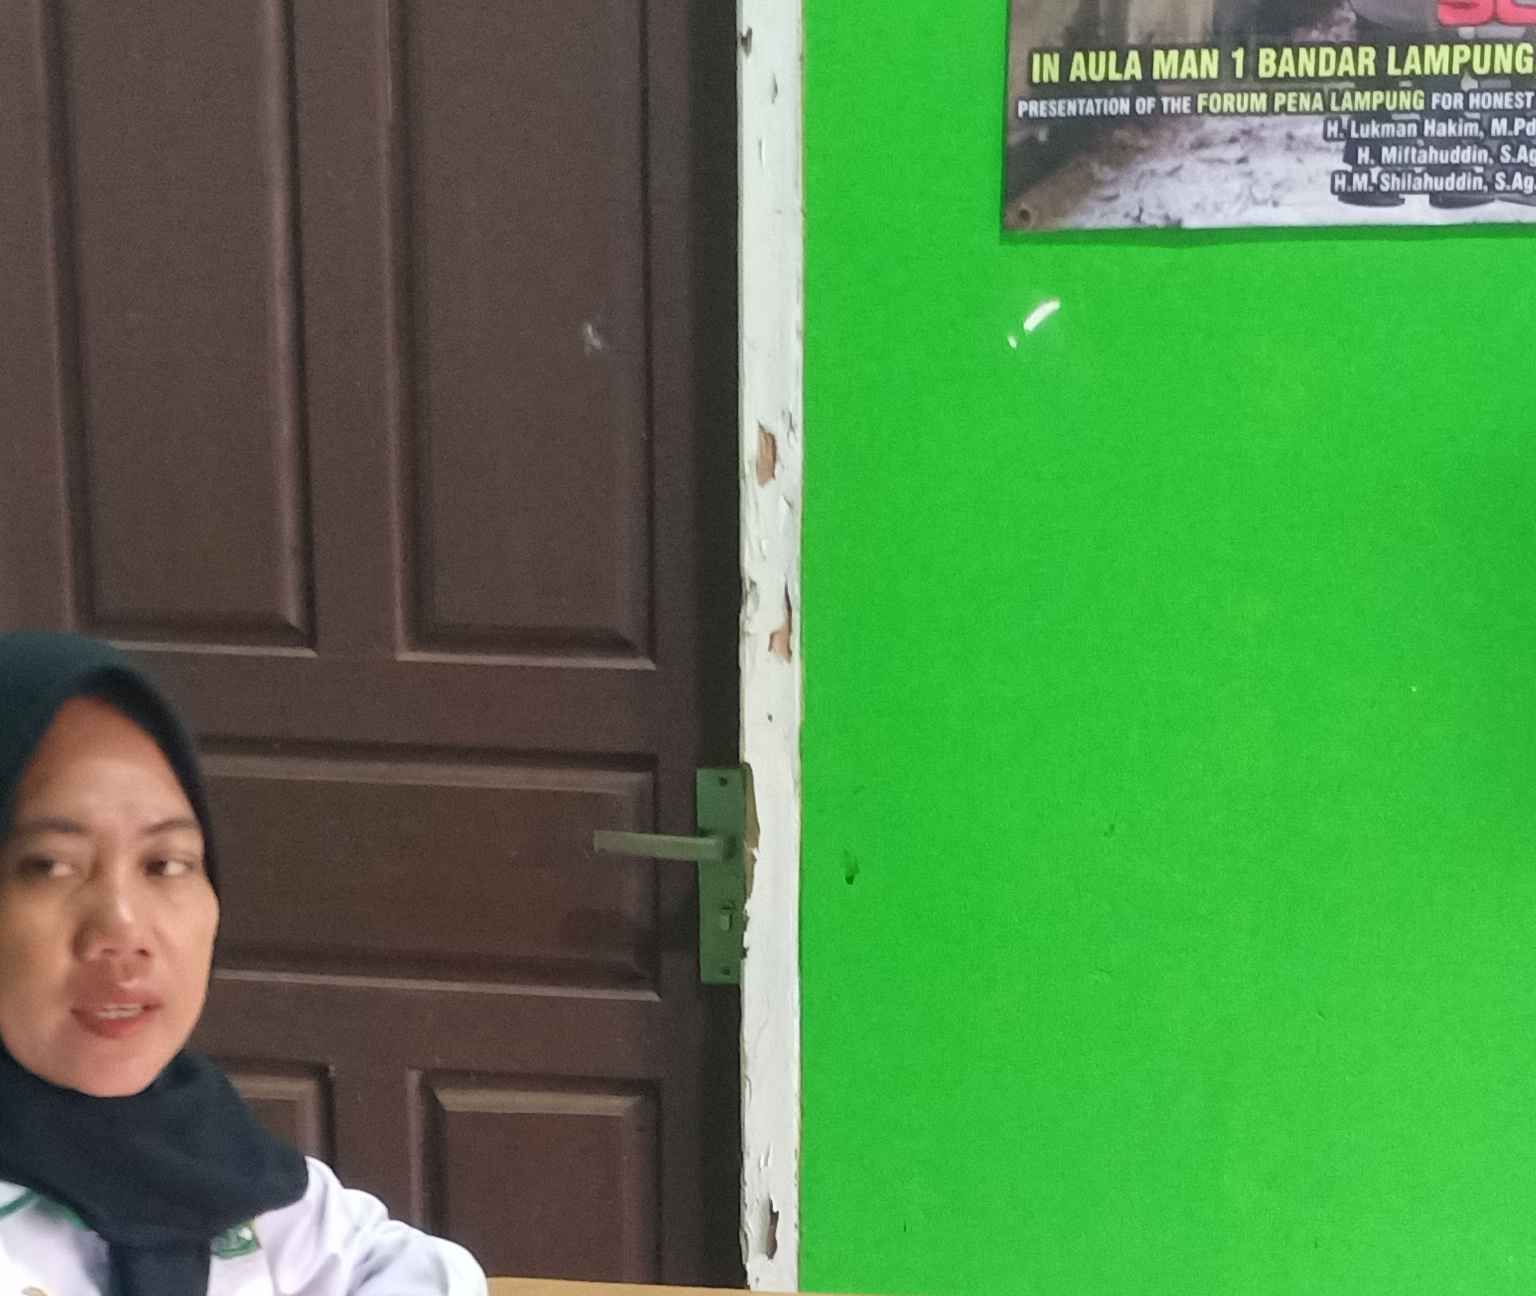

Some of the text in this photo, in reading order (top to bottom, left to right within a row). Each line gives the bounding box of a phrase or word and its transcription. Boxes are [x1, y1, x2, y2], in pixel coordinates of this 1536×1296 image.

[1031, 52, 1060, 83] IN
[1069, 49, 1142, 82] AULA
[1152, 48, 1219, 80] MAN
[1231, 47, 1245, 79] 1
[1258, 45, 1376, 79] BANDAR
[1017, 97, 1131, 118] PRESENTATION
[1135, 96, 1157, 115] OF
[1162, 95, 1192, 115] THE
[1197, 92, 1268, 114] FORUM
[1274, 91, 1324, 113] PENA
[1330, 89, 1425, 111] LAMPUNG
[1431, 92, 1464, 110] FOR
[1469, 91, 1535, 109] HONEST
[1326, 118, 1345, 139] H.
[1351, 117, 1418, 138] Lukman
[1424, 117, 1485, 140] Hakim,
[1491, 117, 1536, 137] M.Pd
[1357, 149, 1375, 165] H.
[1381, 146, 1494, 166] Miftahuddin,
[1334, 173, 1375, 193] H.M.
[1380, 172, 1488, 193] Shilahuddin,
